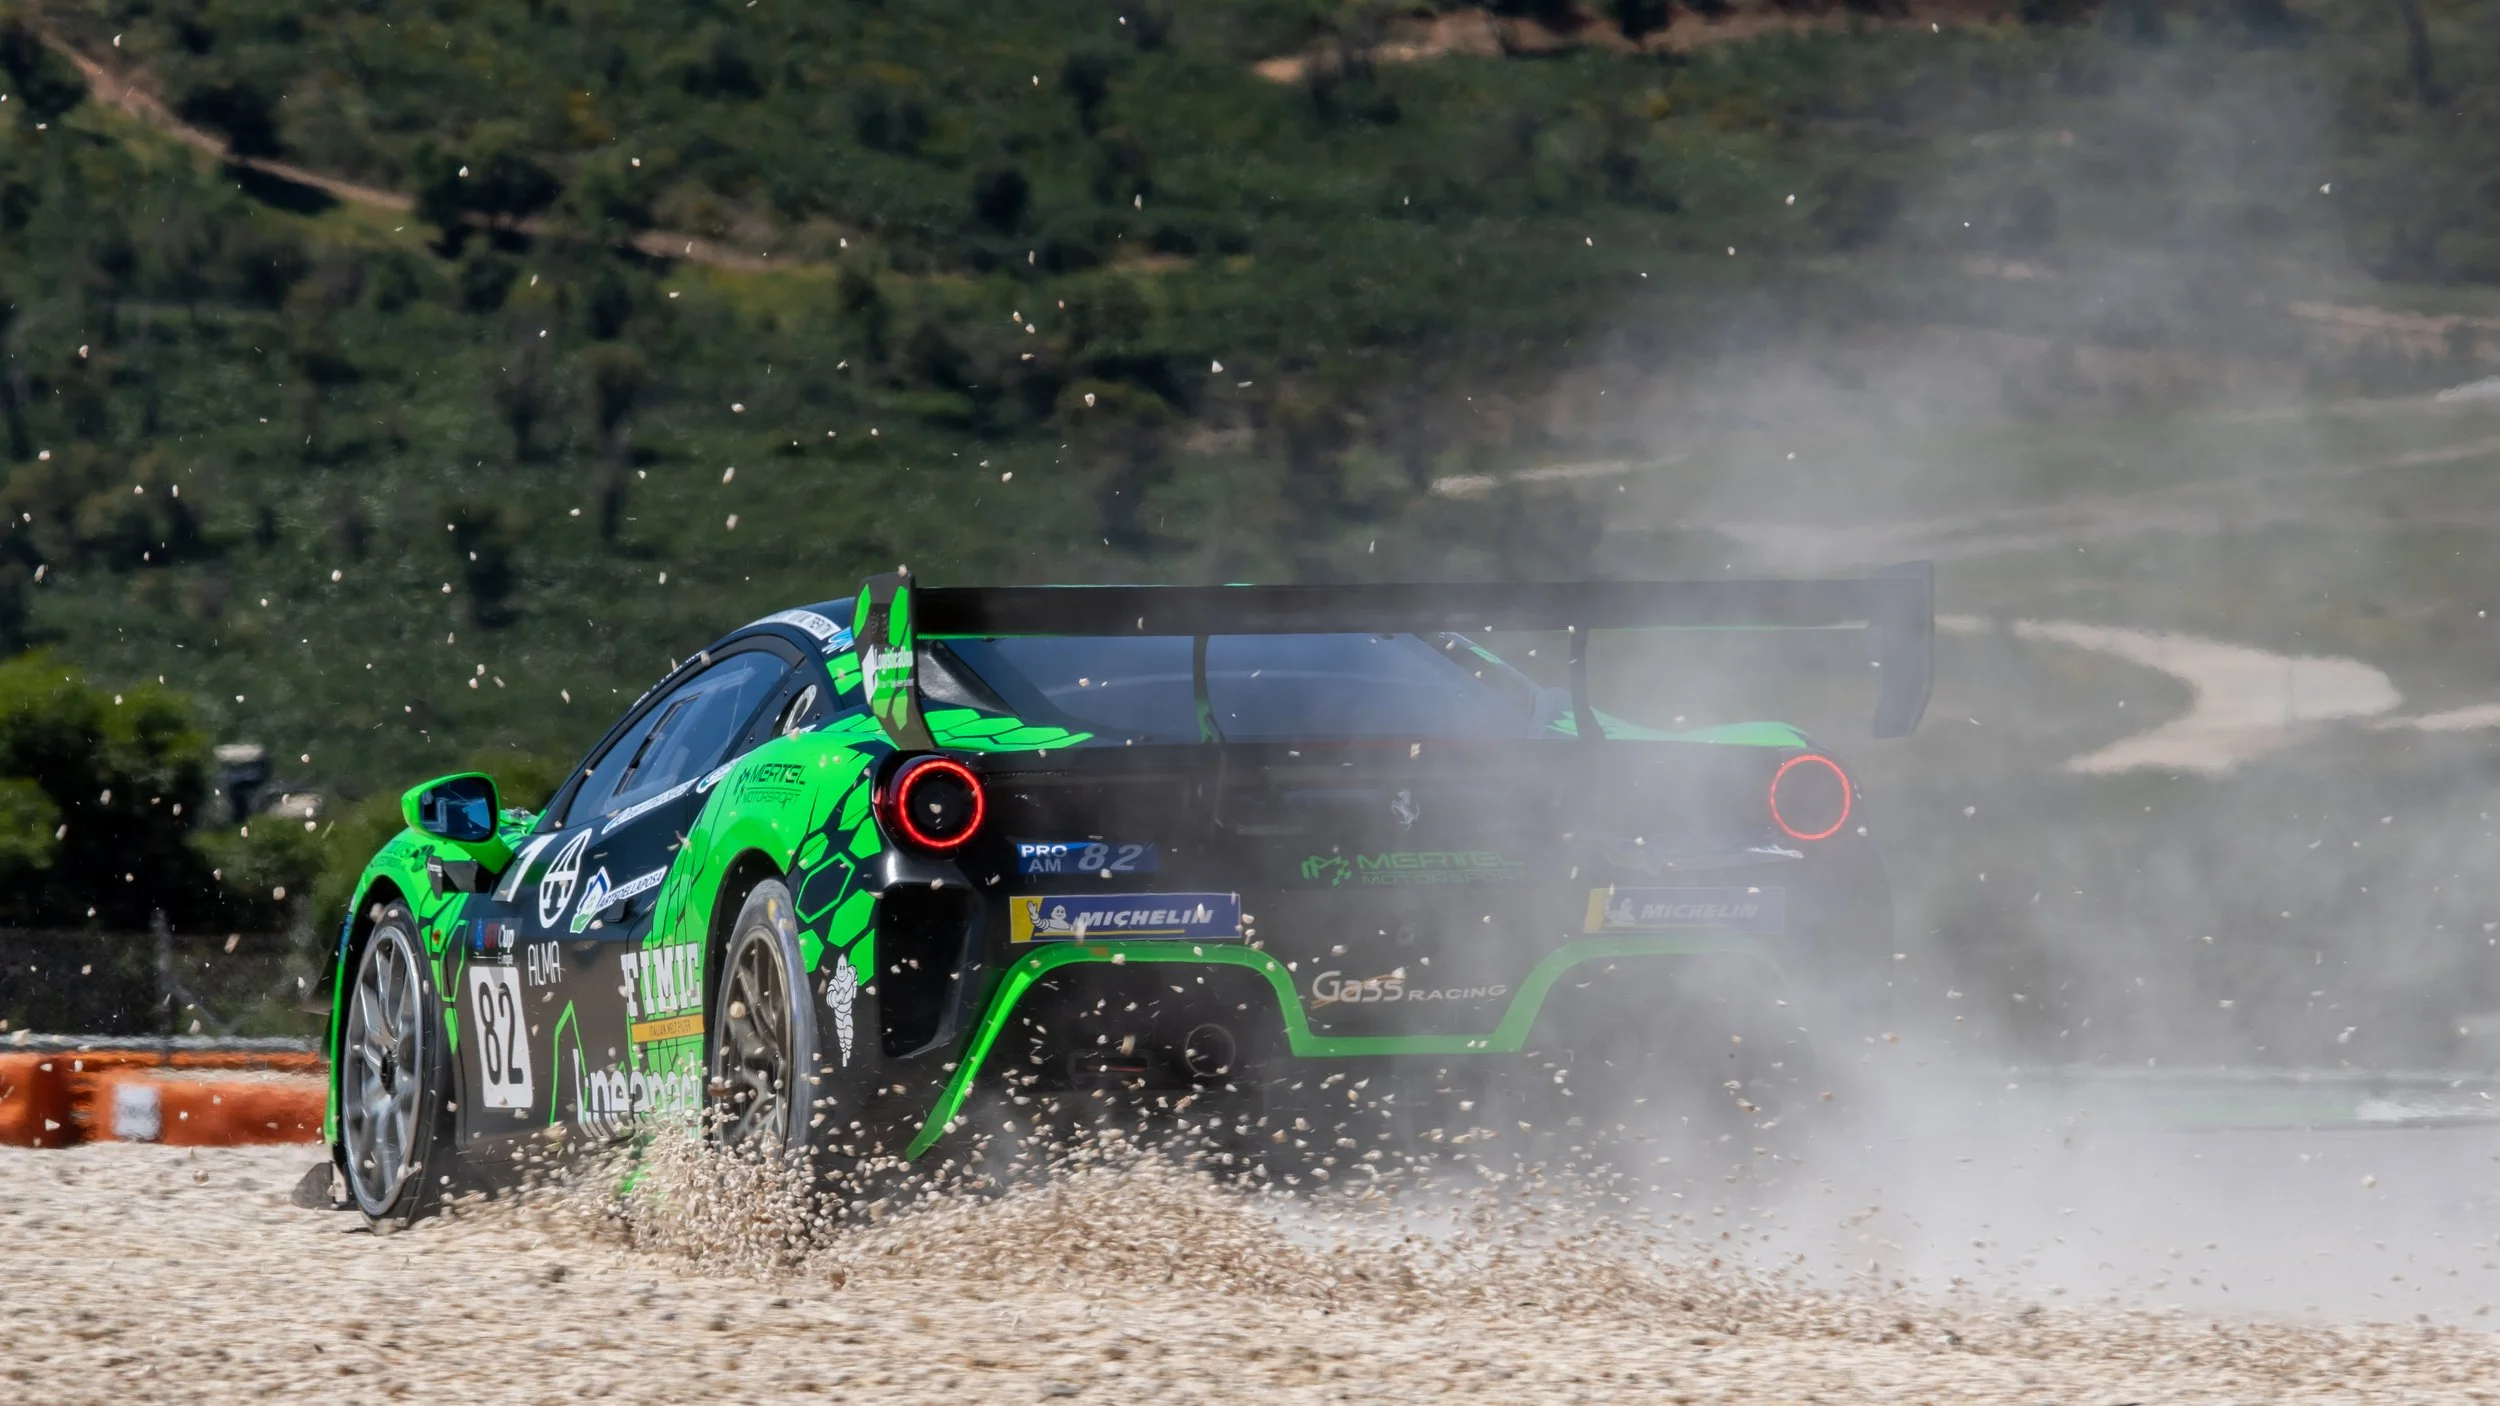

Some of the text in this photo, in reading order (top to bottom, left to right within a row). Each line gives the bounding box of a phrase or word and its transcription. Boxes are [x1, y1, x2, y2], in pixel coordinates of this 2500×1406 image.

[748, 762, 806, 785] MERTEL
[1021, 844, 1067, 858] PRO
[1077, 843, 1144, 872] 82
[1356, 851, 1525, 869] MERTEL
[1028, 858, 1062, 873] AM
[1078, 909, 1215, 927] MICHELIN
[1640, 903, 1759, 921] MICHELIN
[498, 923, 515, 953] Cup
[527, 940, 562, 987] ALMA
[621, 942, 703, 1018] FIMIC
[1312, 970, 1508, 1002] Gass RACING
[478, 981, 524, 1086] 82
